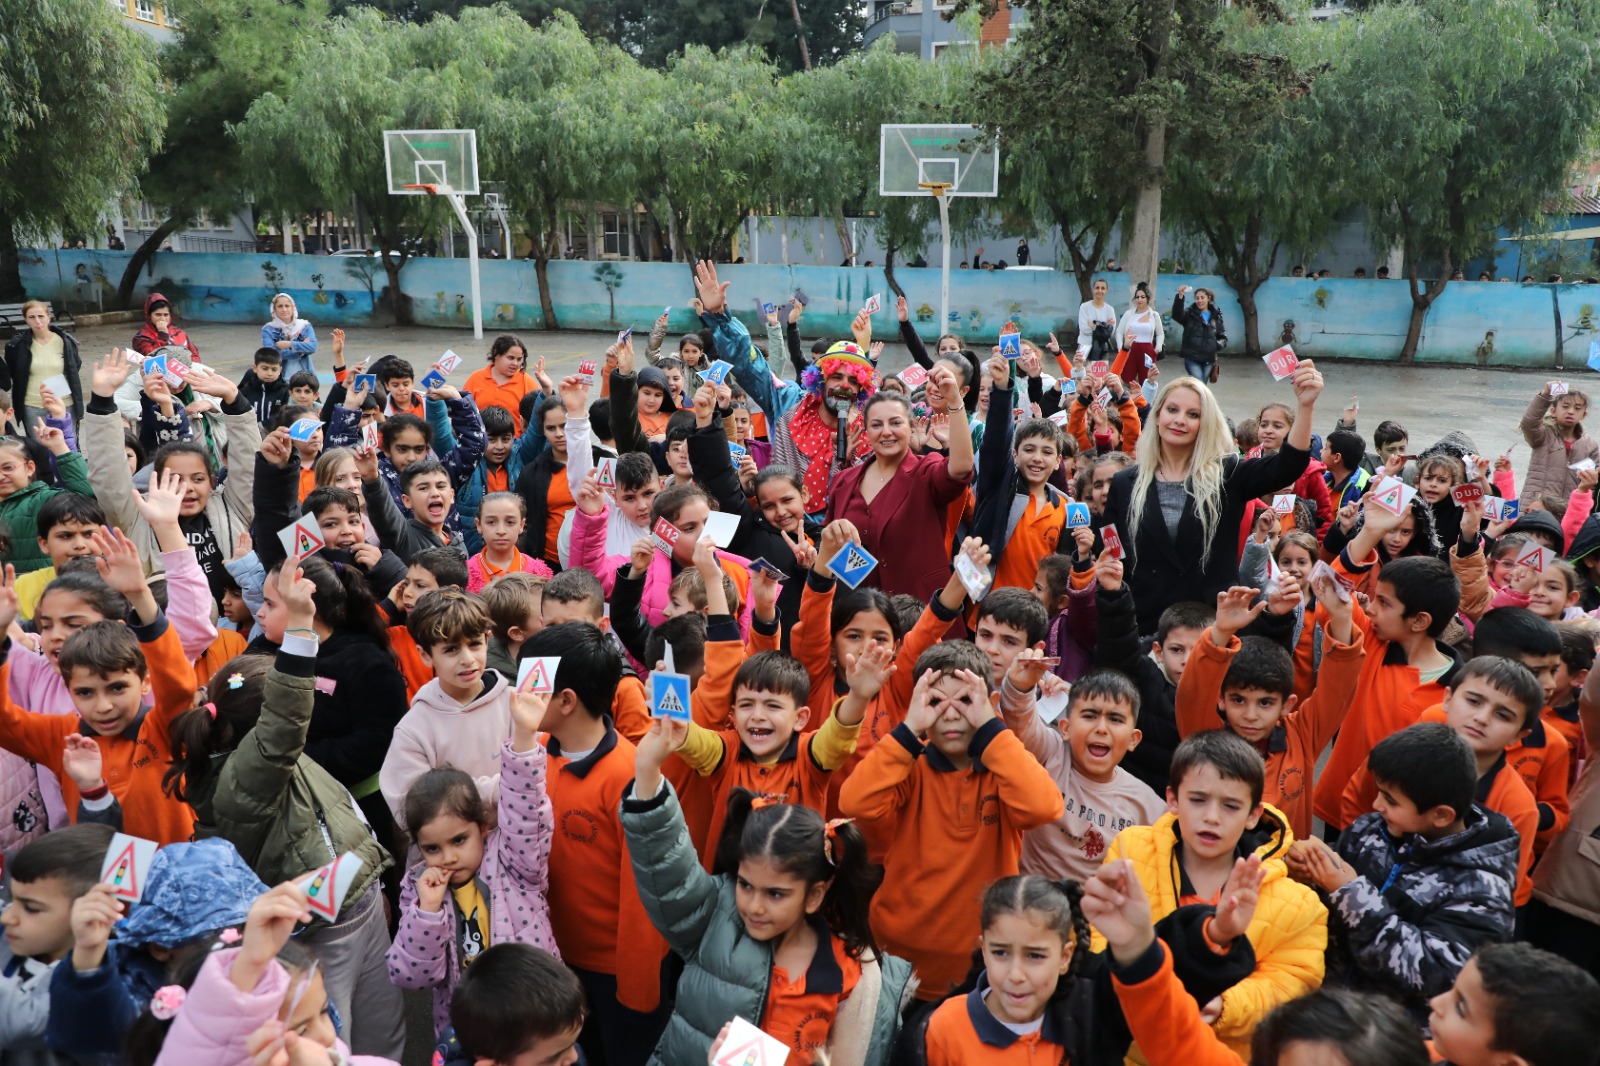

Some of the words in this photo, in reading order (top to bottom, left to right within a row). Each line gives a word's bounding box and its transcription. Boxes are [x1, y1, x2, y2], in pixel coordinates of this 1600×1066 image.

[170, 361, 190, 375] 112
[1271, 354, 1295, 372] DUR
[904, 368, 926, 384] DUR
[1455, 488, 1480, 500] DUR
[660, 523, 679, 543] 112
[1104, 535, 1120, 548] DUR
